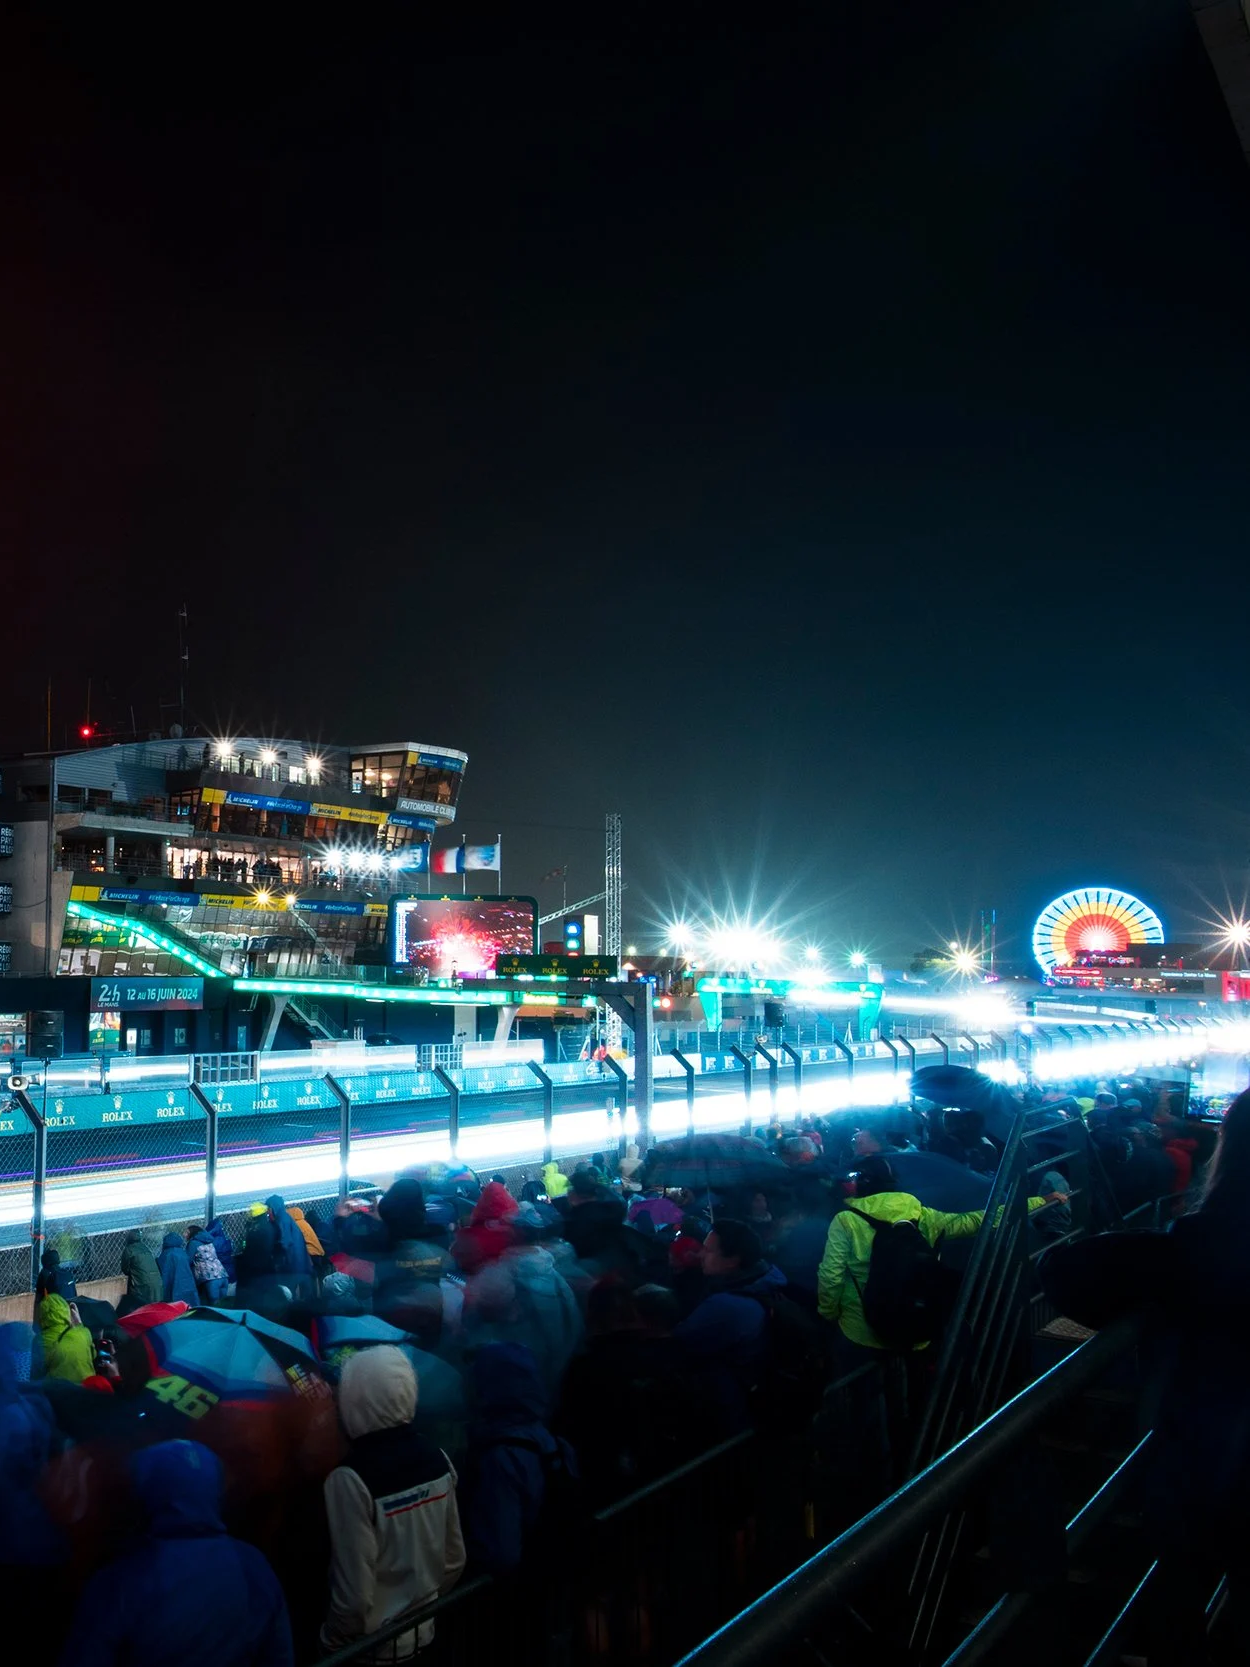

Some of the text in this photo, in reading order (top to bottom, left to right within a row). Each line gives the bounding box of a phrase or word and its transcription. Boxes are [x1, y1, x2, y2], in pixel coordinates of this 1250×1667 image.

[317, 808, 342, 816] MICHELIN
[400, 800, 439, 813] AUTOMOBILE
[109, 892, 140, 900] MICHELIN
[126, 988, 137, 1001] 12
[147, 988, 156, 1000] 16
[156, 988, 177, 1002] JUIN
[177, 988, 198, 1000] 2024
[253, 1099, 278, 1110] ROLEX
[297, 1095, 321, 1105] ROLEX
[156, 1106, 186, 1118] ROLEX
[213, 1103, 233, 1113] OLEX
[45, 1115, 76, 1127] ROLEX
[102, 1110, 133, 1123] ROLEX
[145, 1375, 220, 1420] 46
